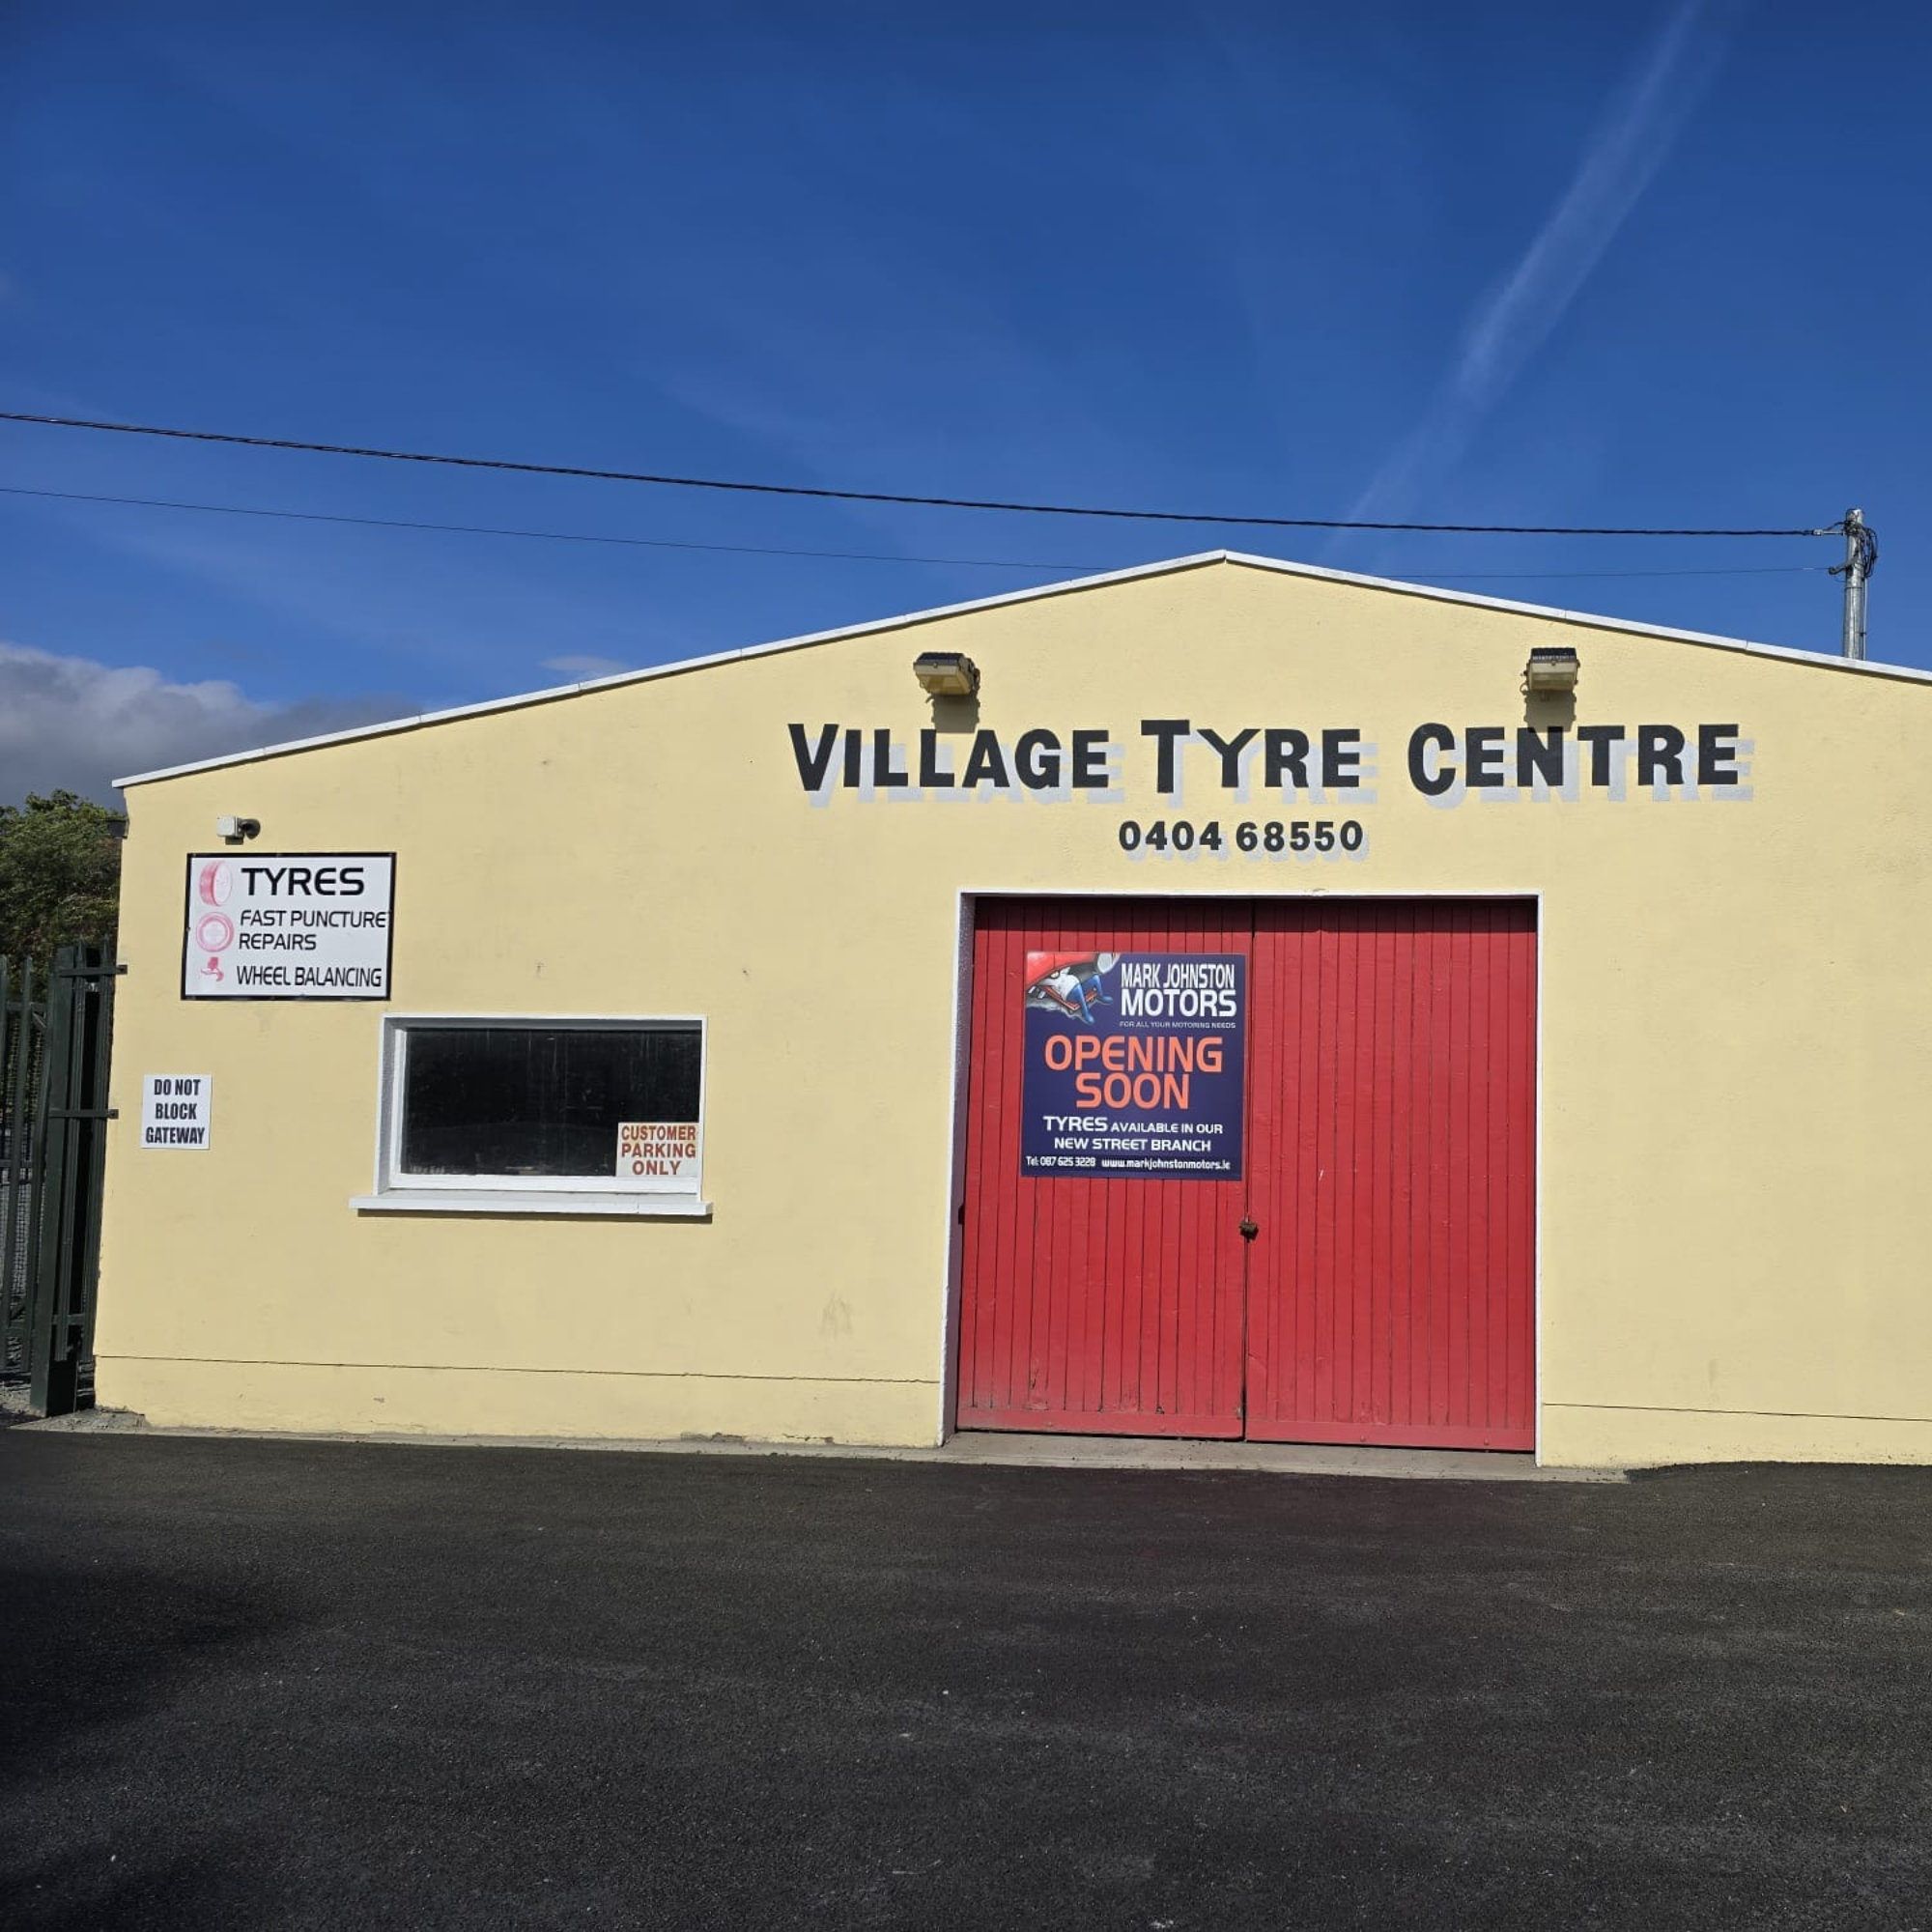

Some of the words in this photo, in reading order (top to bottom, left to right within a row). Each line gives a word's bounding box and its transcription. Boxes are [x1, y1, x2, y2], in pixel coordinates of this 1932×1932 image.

[788, 723, 1110, 791] VILLAGE
[1141, 719, 1360, 793] TYRE
[1407, 722, 1740, 796] CENTRE
[1119, 820, 1222, 851] 0404
[1236, 820, 1363, 852] 68550
[242, 867, 365, 895] TYRES
[241, 910, 287, 926] FAST
[291, 911, 386, 927] PUNCTURE
[239, 933, 317, 951] REPAIRS
[237, 966, 291, 985] WHEEL
[295, 967, 383, 987] BALANCING
[1122, 963, 1161, 988] MARK
[1163, 963, 1235, 989] JOHNSTON
[1122, 988, 1237, 1017] MOTORS
[1044, 1035, 1223, 1072] OPENING
[154, 1079, 172, 1096] DO
[174, 1079, 201, 1096] NOT
[1075, 1072, 1189, 1109] SOON
[155, 1102, 197, 1121] BLOCK
[621, 1125, 696, 1141] CUSTOMER
[1043, 1116, 1108, 1132] TYRES
[1110, 1122, 1179, 1133] AVAILABLE
[1180, 1123, 1194, 1134] IN
[1196, 1123, 1224, 1135] OUR
[145, 1126, 205, 1146] GATEWAY
[1054, 1138, 1089, 1150] NEW
[1092, 1138, 1148, 1151] STREET
[1151, 1140, 1211, 1152] BRANCH
[621, 1143, 696, 1158] PARKING
[632, 1160, 681, 1176] ONLY
[1039, 1156, 1057, 1167] 087
[1058, 1156, 1074, 1167] 625
[1101, 1158, 1231, 1171] www.markjohnstonmotors.ie
